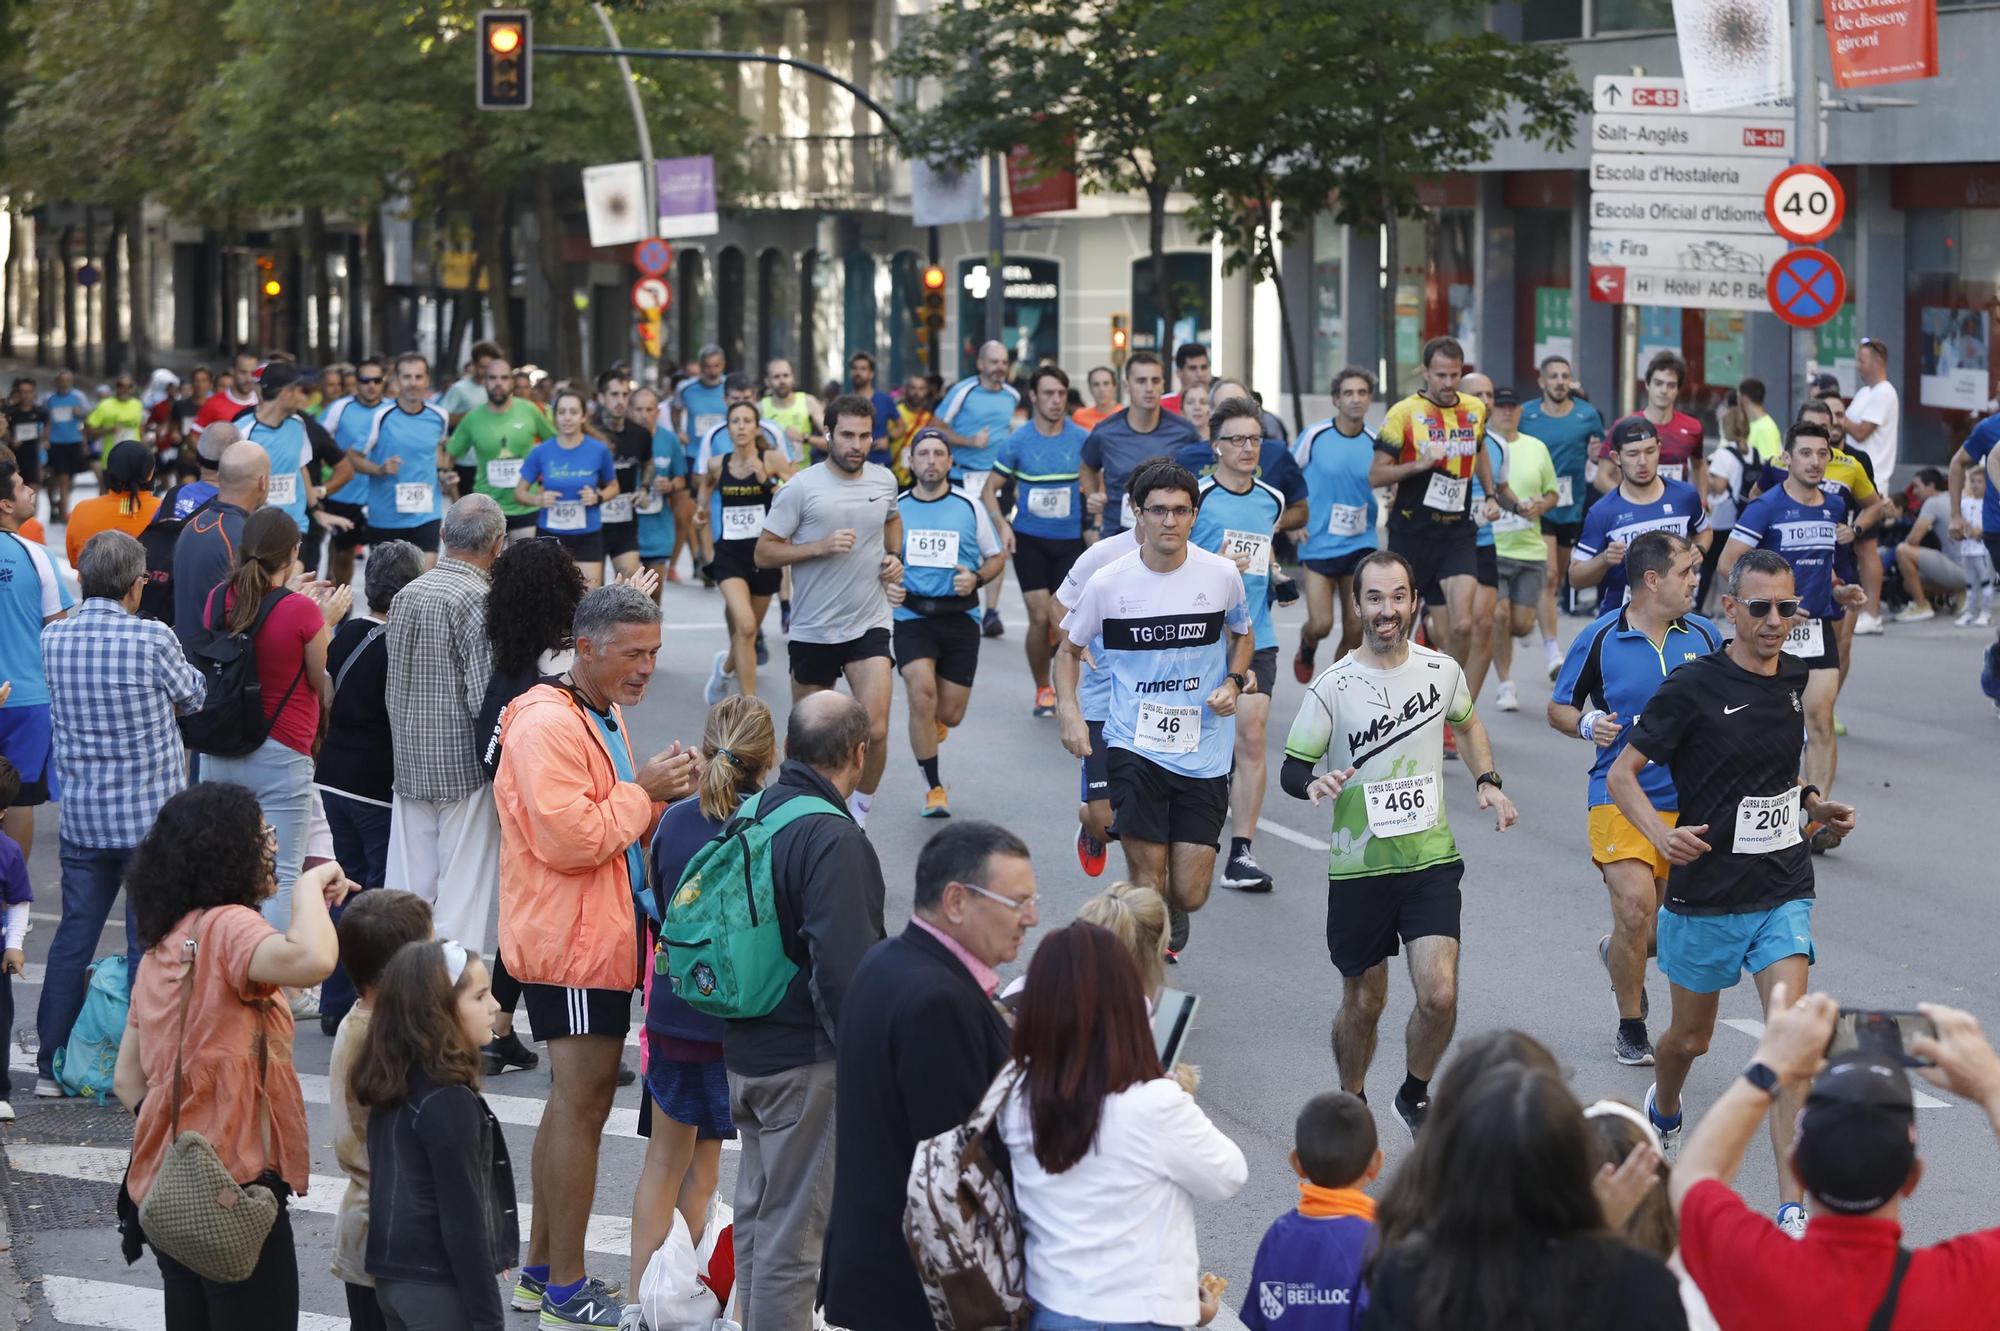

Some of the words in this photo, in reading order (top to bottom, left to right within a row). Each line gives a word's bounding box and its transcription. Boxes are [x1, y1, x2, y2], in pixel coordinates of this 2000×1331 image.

[1834, 15, 1854, 31] de
[1855, 11, 1907, 28] disseny
[1634, 89, 1677, 106] C-65
[1598, 124, 1689, 146] Salt-Anglès
[1745, 129, 1783, 146] N-141
[1595, 164, 1645, 181] Escola
[1650, 166, 1740, 184] d'Hostaleria
[1595, 202, 1645, 219] Escola
[1650, 203, 1697, 221] Oficial
[1782, 191, 1828, 217] 40
[1620, 240, 1648, 256] Fira
[1665, 280, 1701, 296] Hotel
[1708, 282, 1729, 298] AC
[1733, 284, 1744, 299] P.
[1042, 495, 1058, 508] 80
[732, 513, 756, 526] 626
[919, 537, 947, 552] 619
[1234, 540, 1261, 557] 567
[1130, 624, 1176, 643] TGCB
[1178, 623, 1207, 639] INN
[1684, 652, 1697, 661] HH
[1135, 678, 1184, 693] runner
[1184, 677, 1199, 691] INN
[1142, 703, 1155, 712] CURSA
[1164, 707, 1179, 716] CARRER
[1157, 716, 1181, 733] 46
[1368, 784, 1384, 794] CURSA
[1385, 782, 1394, 792] DEL
[1395, 780, 1414, 790] CARRER
[1385, 789, 1425, 812] 466
[1742, 800, 1760, 808] CURSA
[1761, 799, 1770, 809] DEL
[1373, 818, 1408, 828] montepio
[1755, 805, 1790, 830] 200
[1739, 834, 1773, 843] montepio
